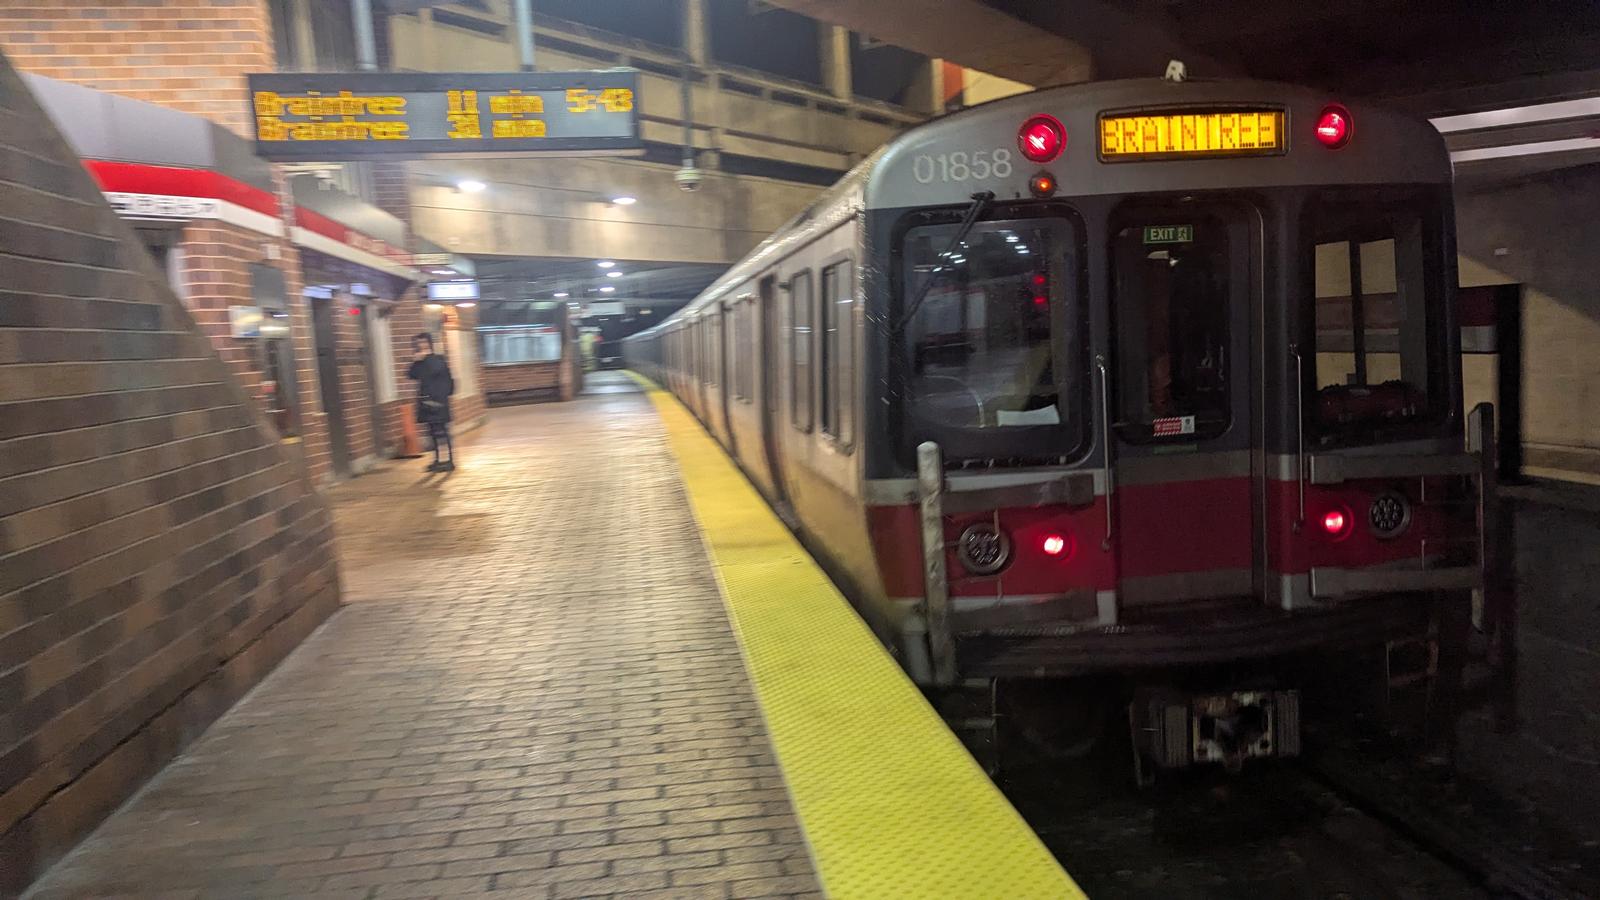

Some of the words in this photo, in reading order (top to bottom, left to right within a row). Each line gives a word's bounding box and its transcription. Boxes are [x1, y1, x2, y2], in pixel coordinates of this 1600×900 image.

[1101, 112, 1275, 153] BRAINTREE
[912, 147, 1013, 184] 01858
[1150, 228, 1176, 241] EXIT
